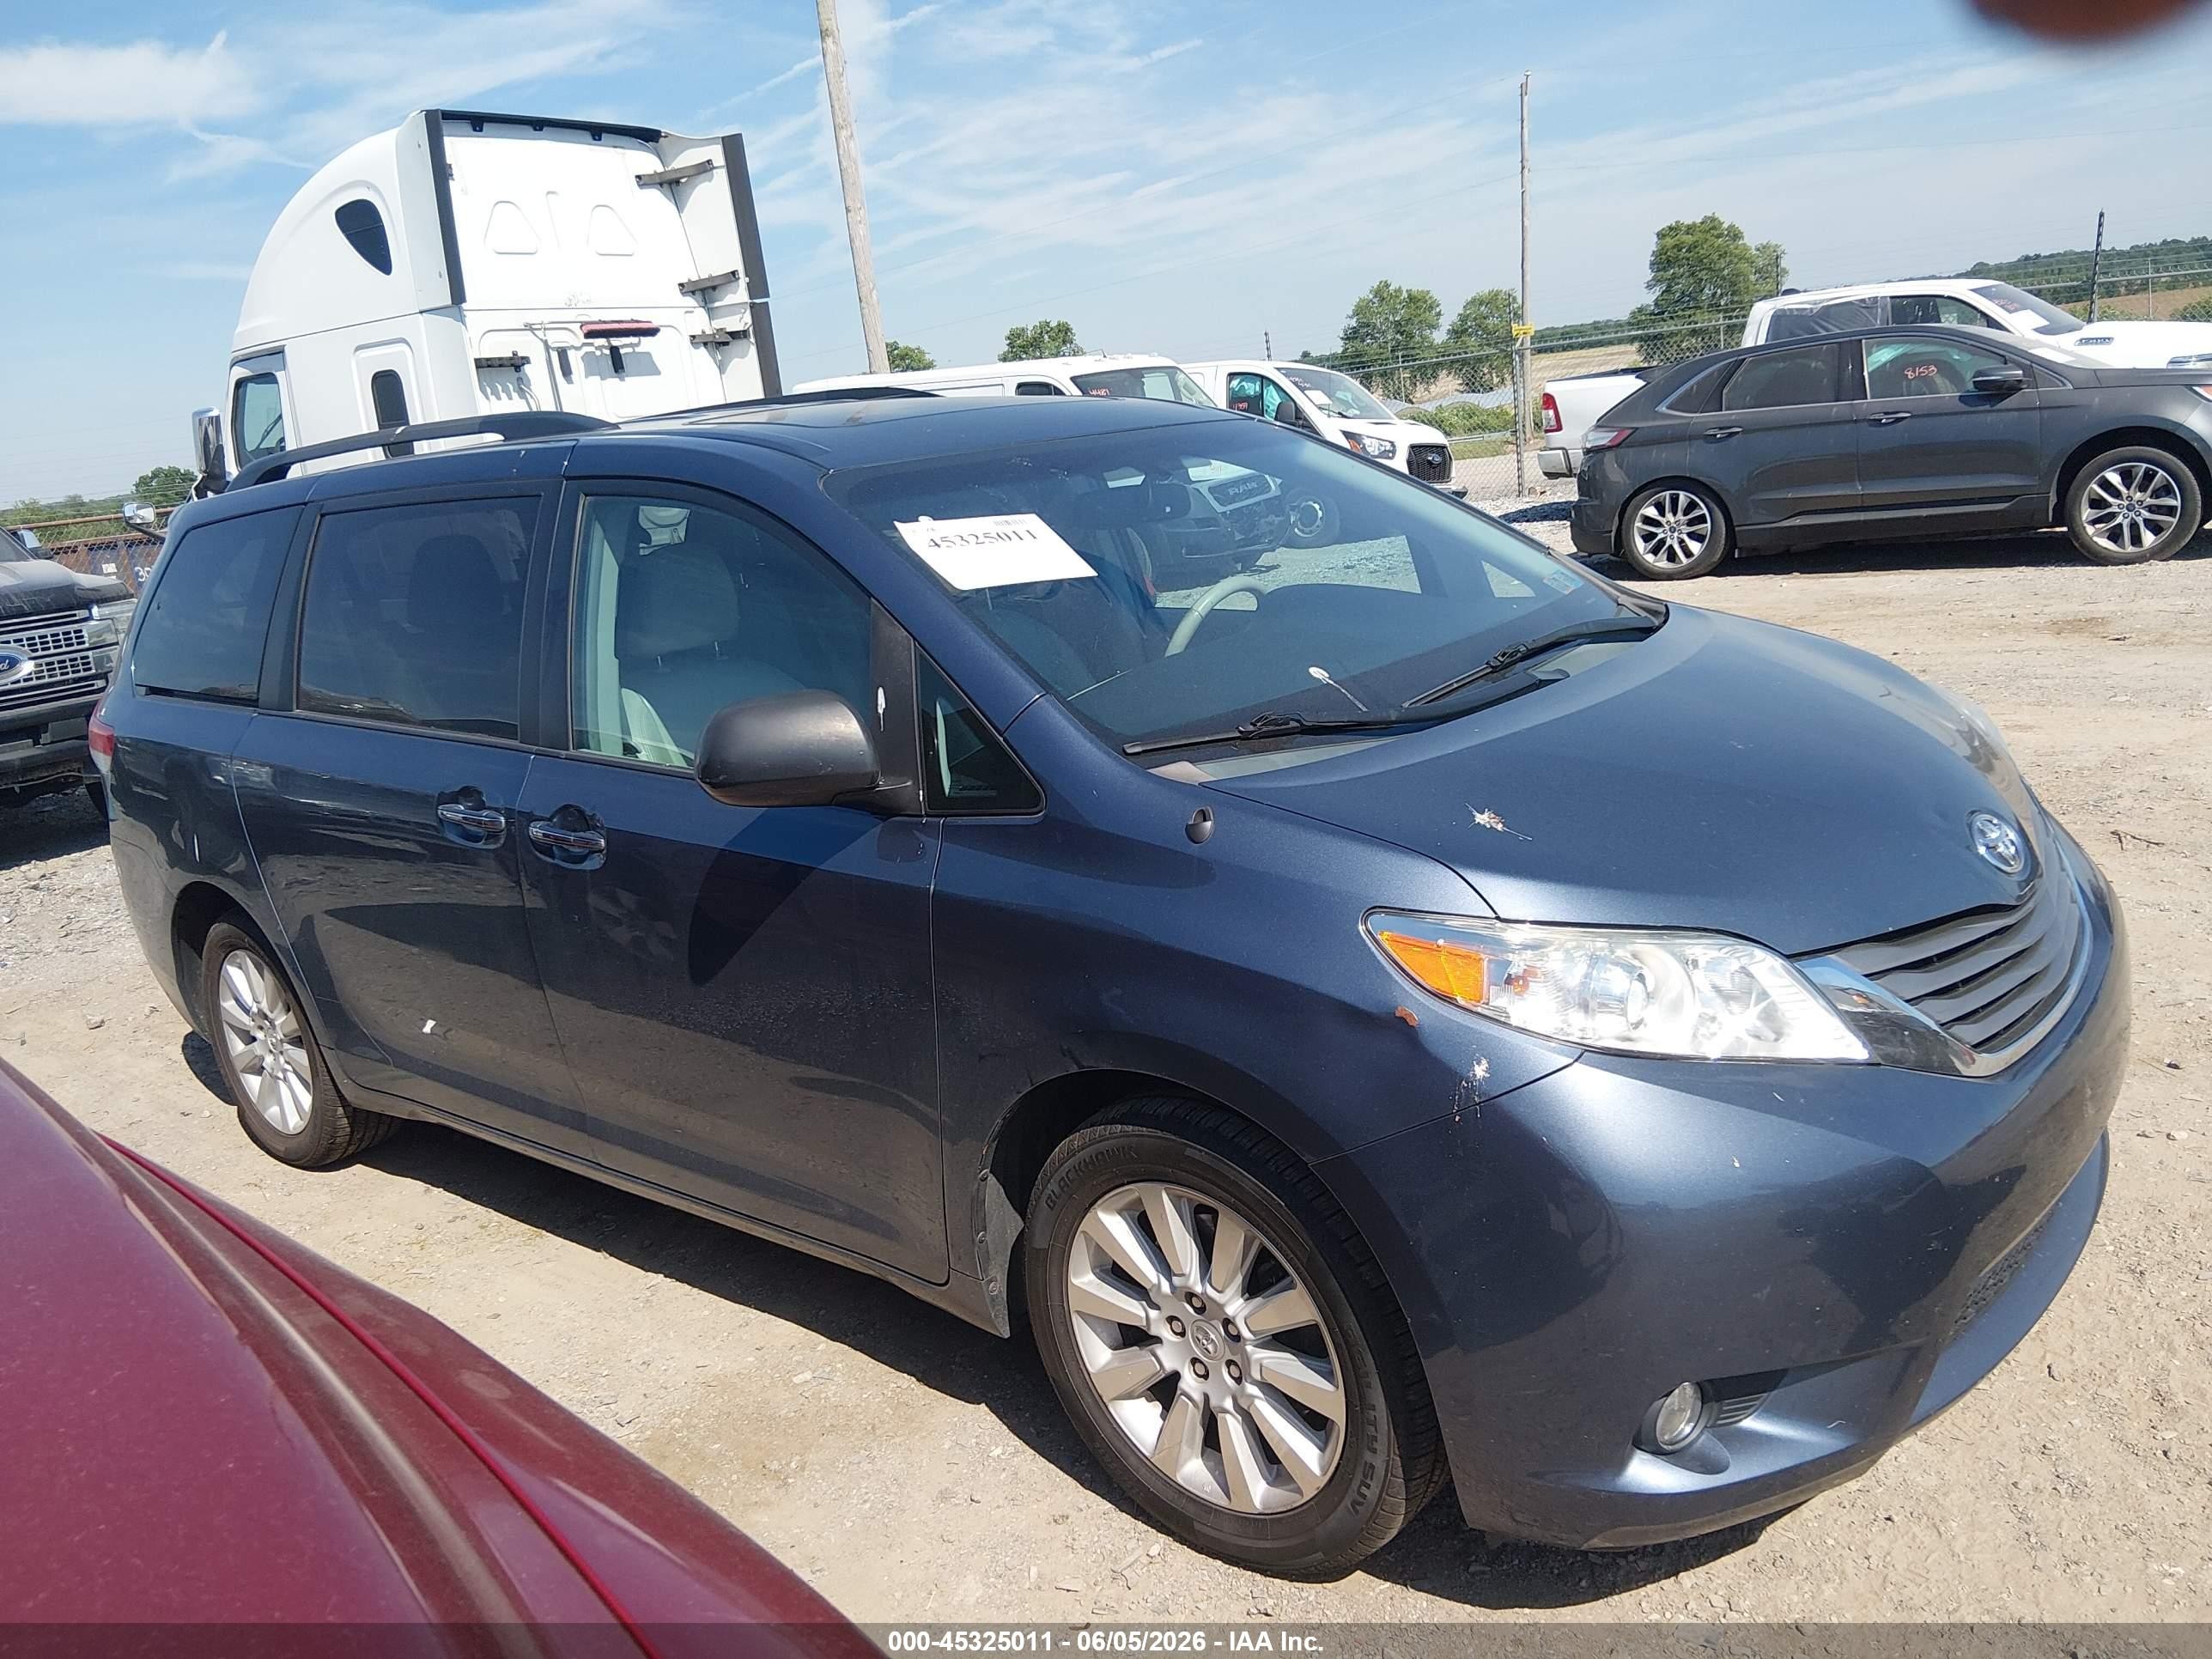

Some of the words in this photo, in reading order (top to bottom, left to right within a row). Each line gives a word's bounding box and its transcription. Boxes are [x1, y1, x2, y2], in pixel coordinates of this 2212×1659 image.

[1904, 364, 1938, 380] 8153
[927, 528, 1038, 550] 45325011
[1349, 1460, 1376, 1517] SUV
